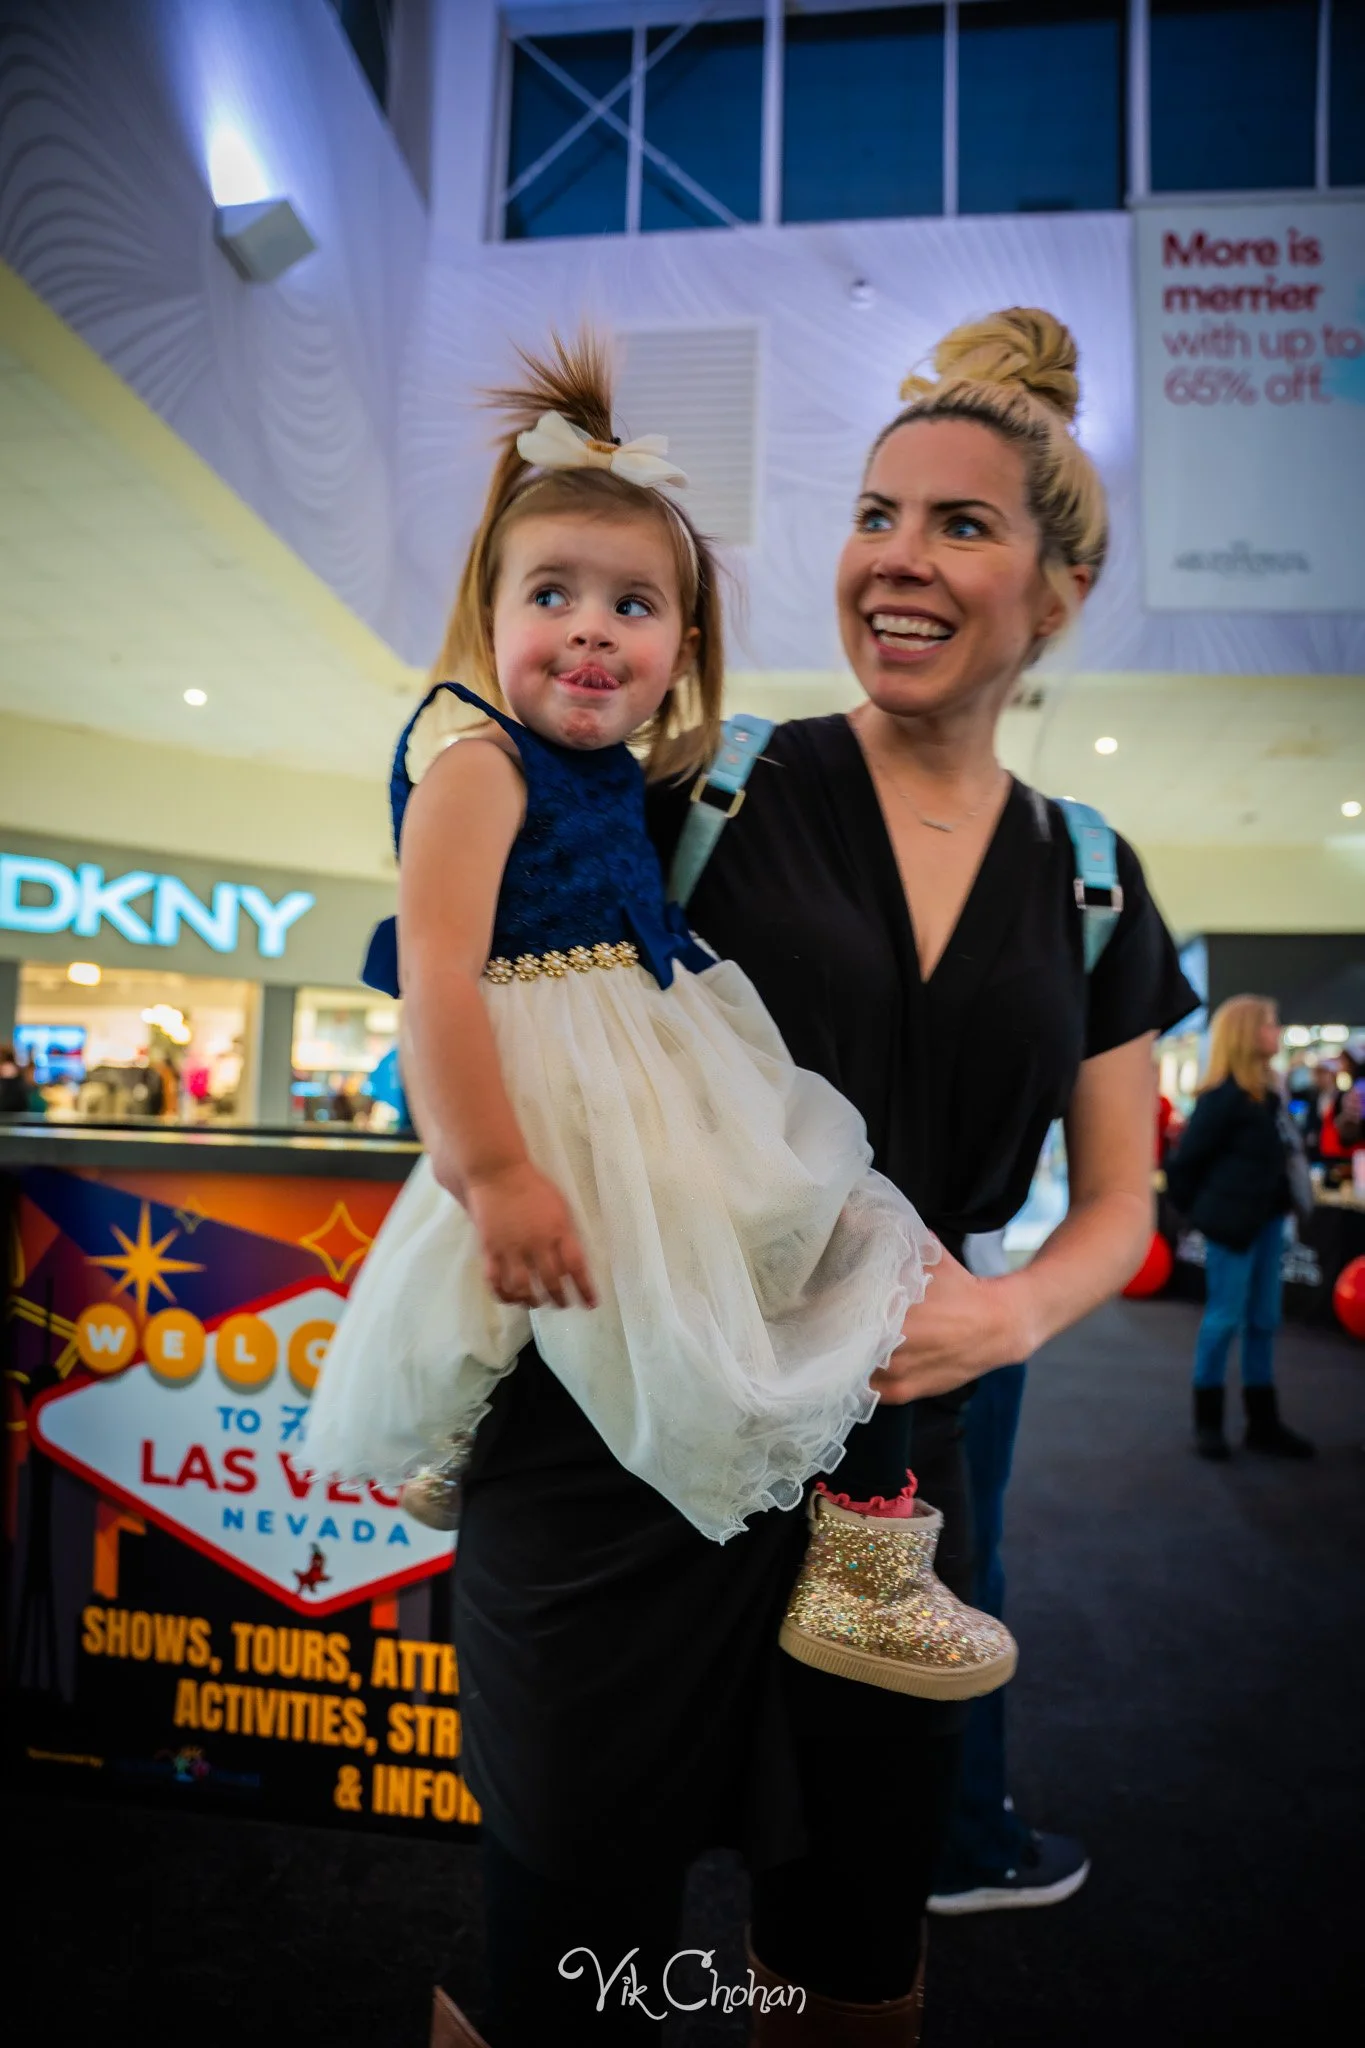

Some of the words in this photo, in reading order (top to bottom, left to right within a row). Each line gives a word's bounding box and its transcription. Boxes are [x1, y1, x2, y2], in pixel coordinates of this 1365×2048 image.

[1162, 230, 1280, 269] More
[1285, 227, 1324, 268] is
[1162, 274, 1324, 314] merrier
[1162, 321, 1252, 359] with
[1258, 328, 1317, 366] up
[1321, 323, 1364, 358] to
[1163, 366, 1257, 406] 65%
[0, 852, 316, 958] DKNY
[216, 1405, 261, 1434] TO
[140, 1439, 259, 1494] LAS
[222, 1507, 411, 1546] NEVADA
[82, 1605, 223, 1675] SHOWS,
[231, 1621, 362, 1691] TOURS,
[173, 1678, 378, 1756] ACTIVITIES,
[387, 1701, 463, 1759] STR
[333, 1764, 363, 1812] &
